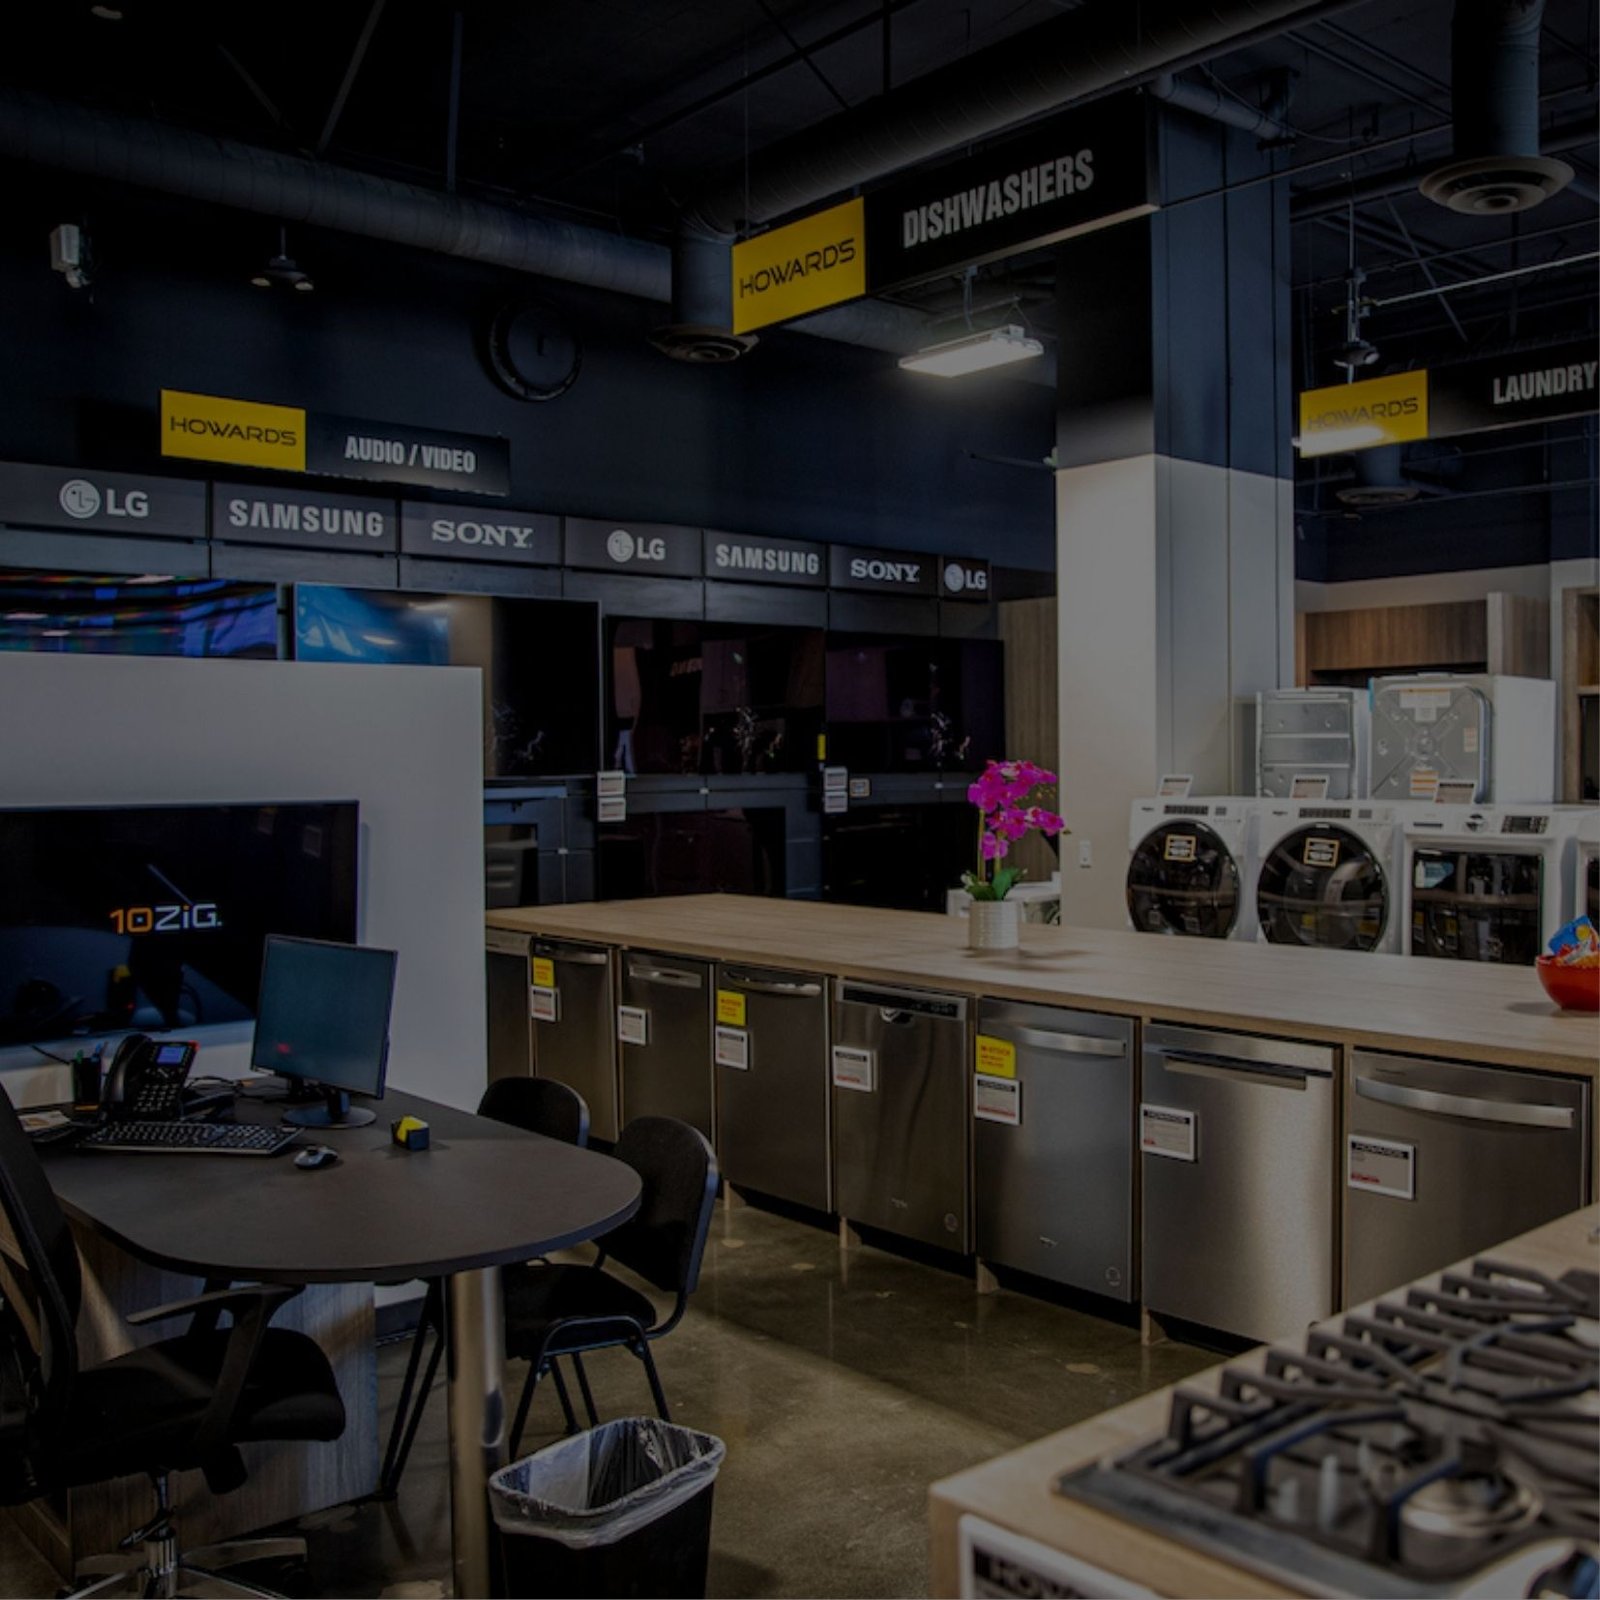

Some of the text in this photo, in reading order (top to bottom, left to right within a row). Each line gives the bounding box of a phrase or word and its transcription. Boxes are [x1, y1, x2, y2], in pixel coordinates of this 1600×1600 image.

[740, 149, 1094, 298] HOWARDS DISHWASHERS
[1307, 360, 1598, 429] HOWARDS LAUNDRY
[170, 415, 297, 447] HOWARDS
[345, 435, 404, 464] AUDIO
[422, 445, 477, 474] VIDEO
[106, 489, 149, 518] LG
[229, 499, 384, 537] SAMSUNG
[431, 519, 533, 548] SONY
[636, 537, 666, 561] LG
[715, 543, 820, 575] SAMSUNG
[850, 558, 920, 583] SONY
[965, 568, 987, 591] LG
